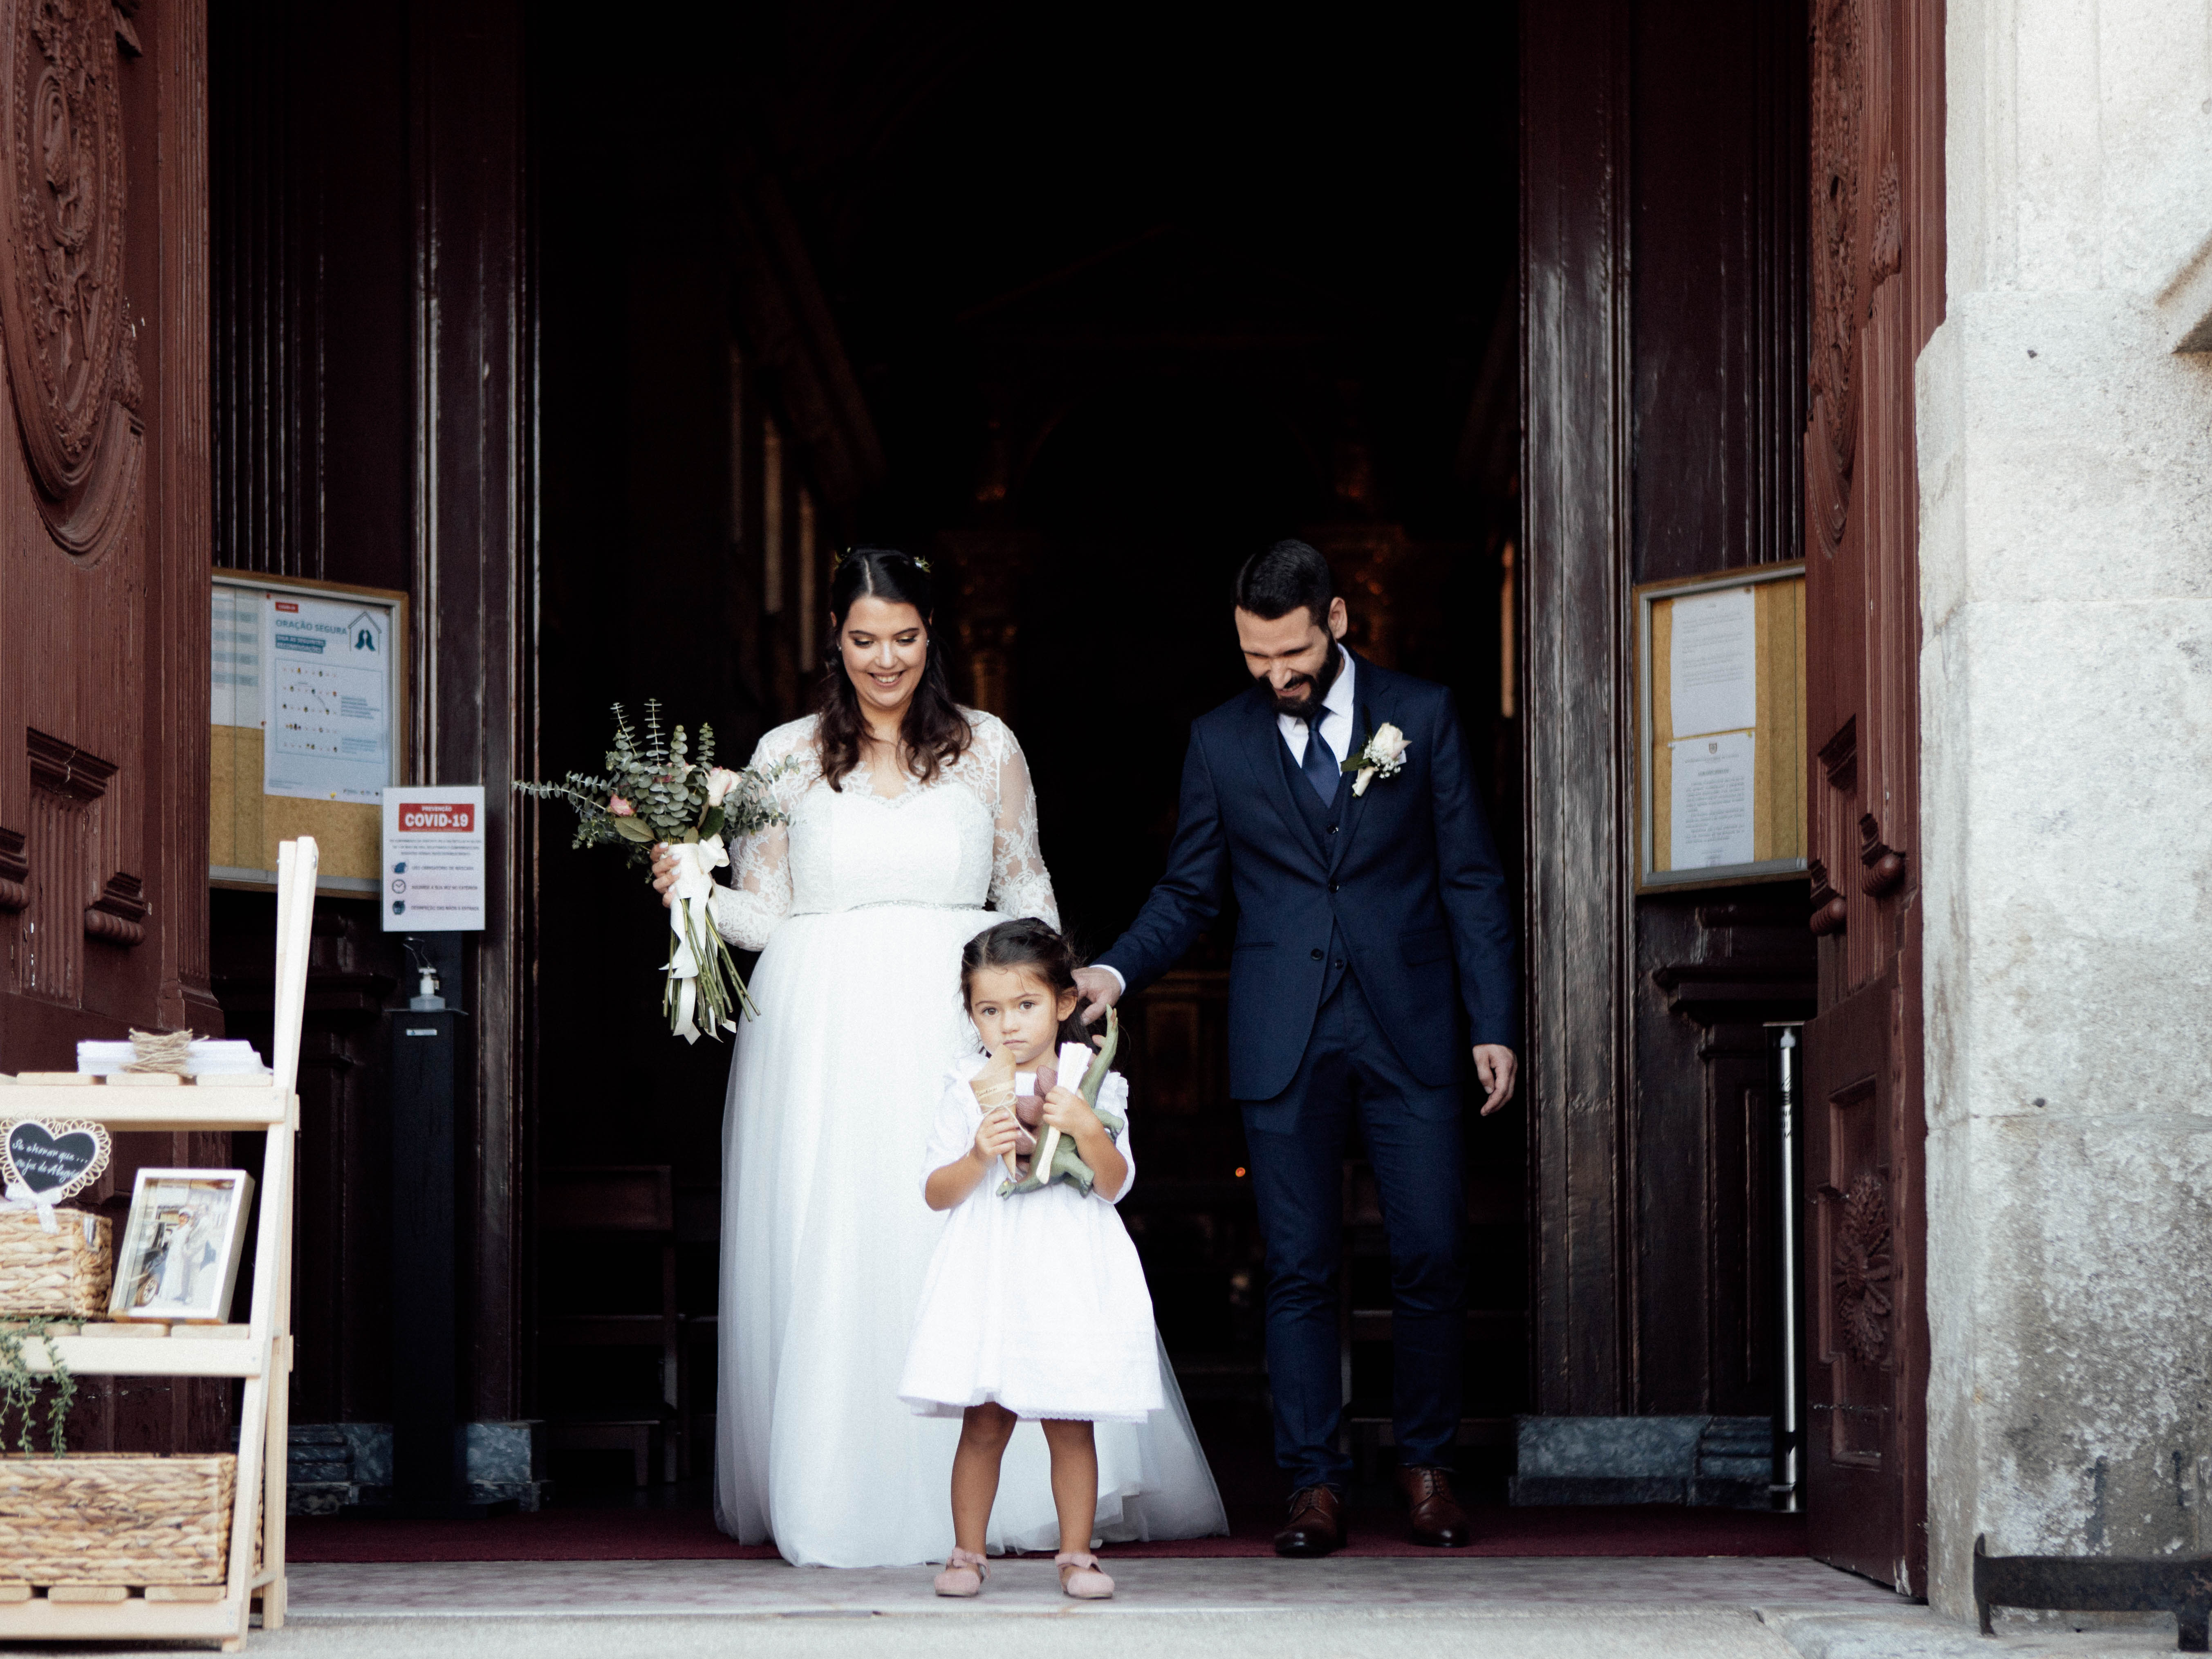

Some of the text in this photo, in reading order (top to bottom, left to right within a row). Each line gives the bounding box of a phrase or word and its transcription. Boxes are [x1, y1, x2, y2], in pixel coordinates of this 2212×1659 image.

[276, 619, 347, 635] ORAÇÃO SEGURA
[405, 813, 468, 827] COVID-19
[12, 1139, 25, 1150] Se
[26, 1143, 58, 1158] chorar
[38, 1161, 47, 1173] de
